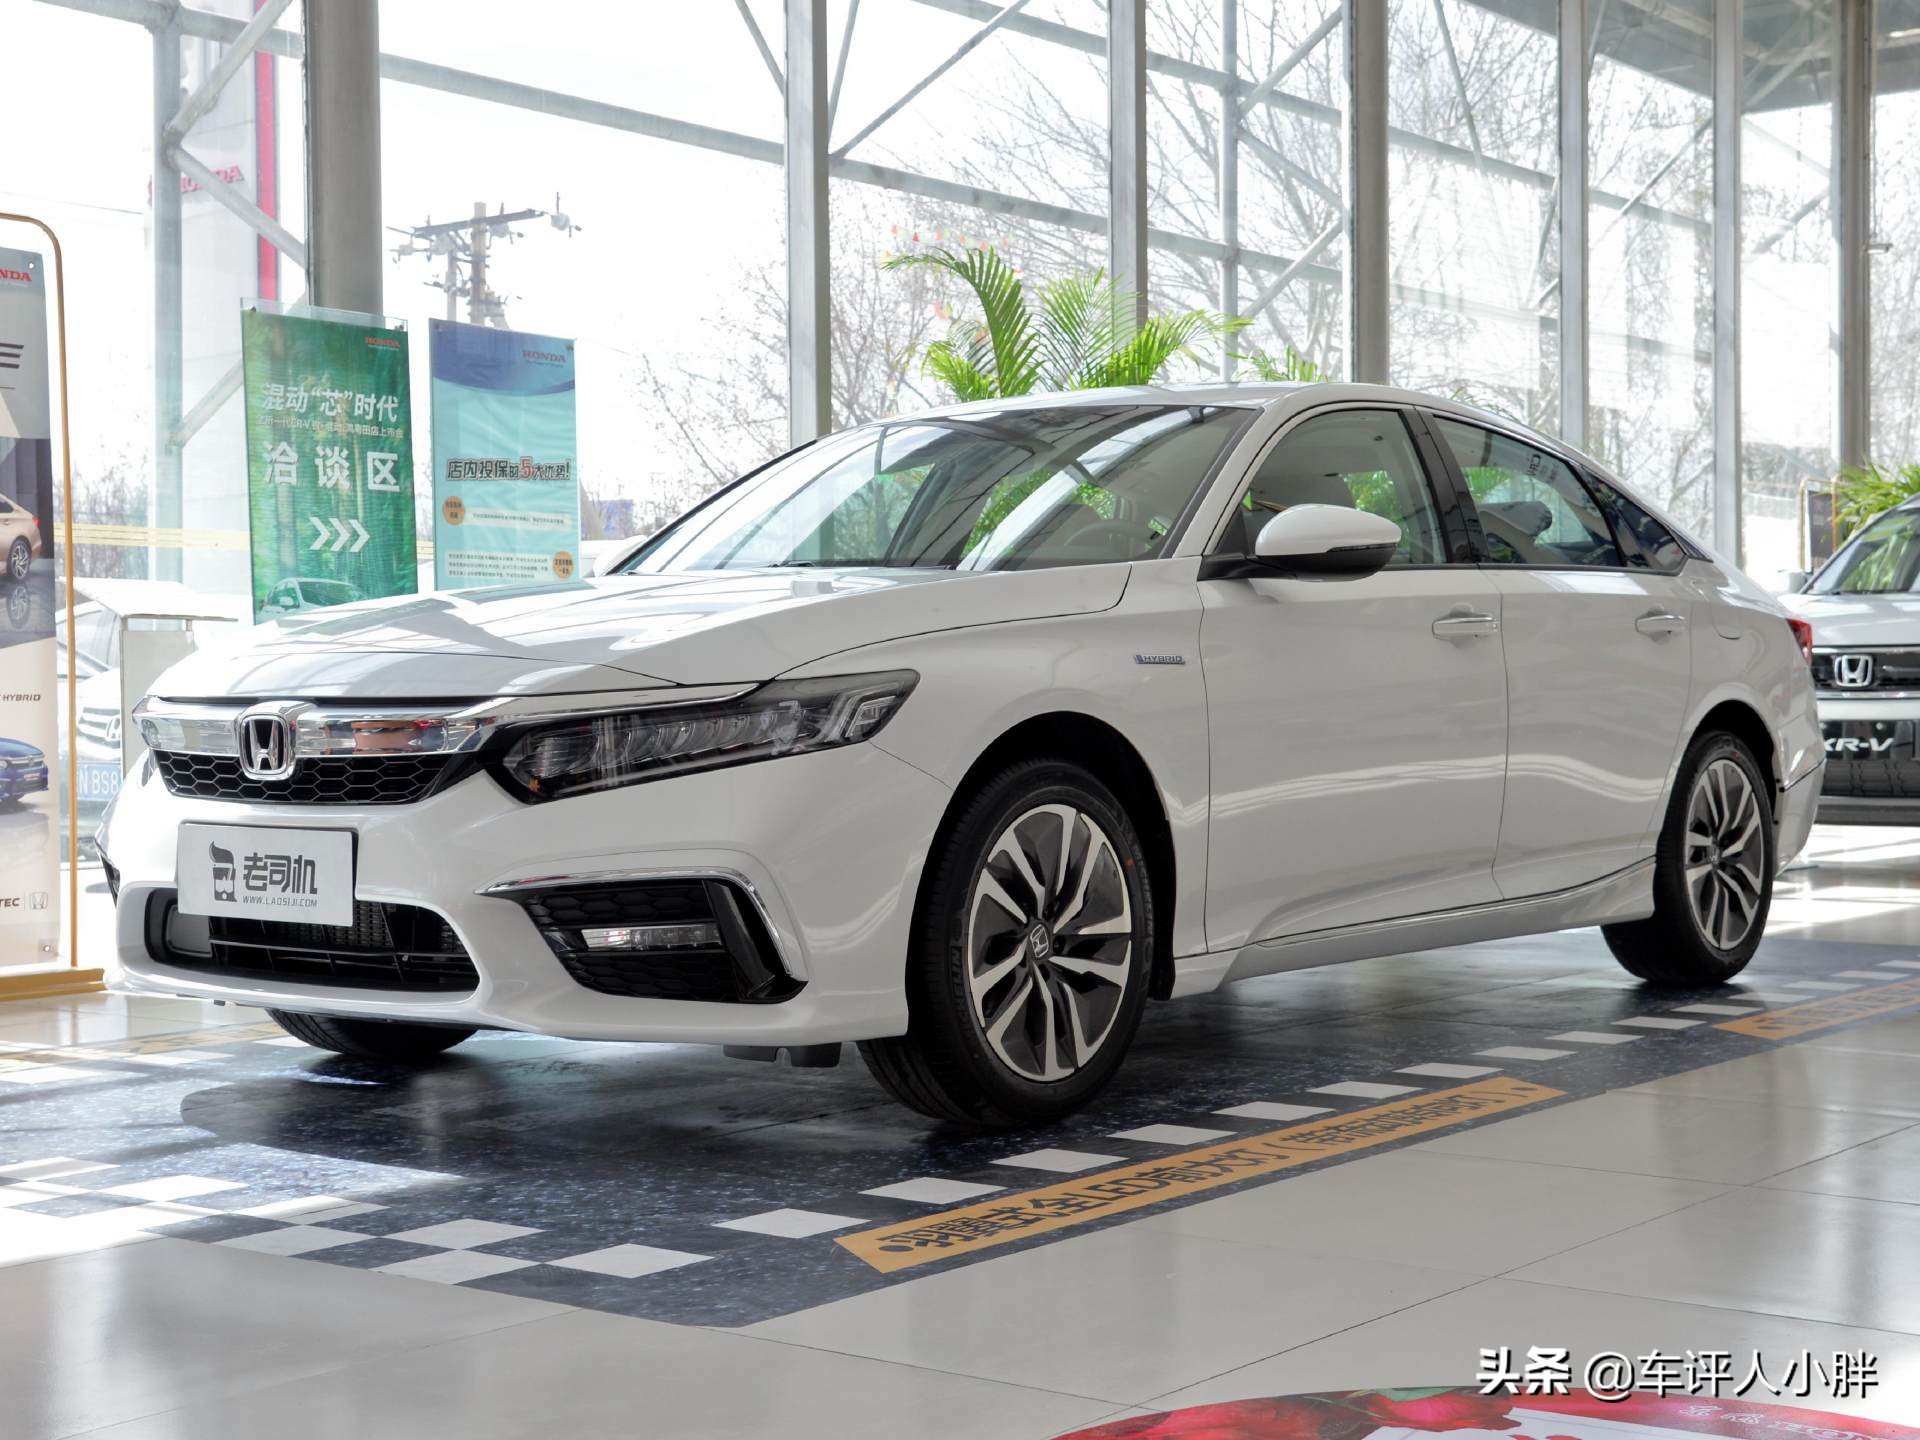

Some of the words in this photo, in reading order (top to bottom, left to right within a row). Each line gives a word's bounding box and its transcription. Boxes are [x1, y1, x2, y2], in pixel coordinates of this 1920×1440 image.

[522, 350, 567, 363] HONDA
[263, 441, 401, 492] 洽谈区
[1143, 655, 1184, 663] HYBRID
[243, 852, 318, 895] 老司机
